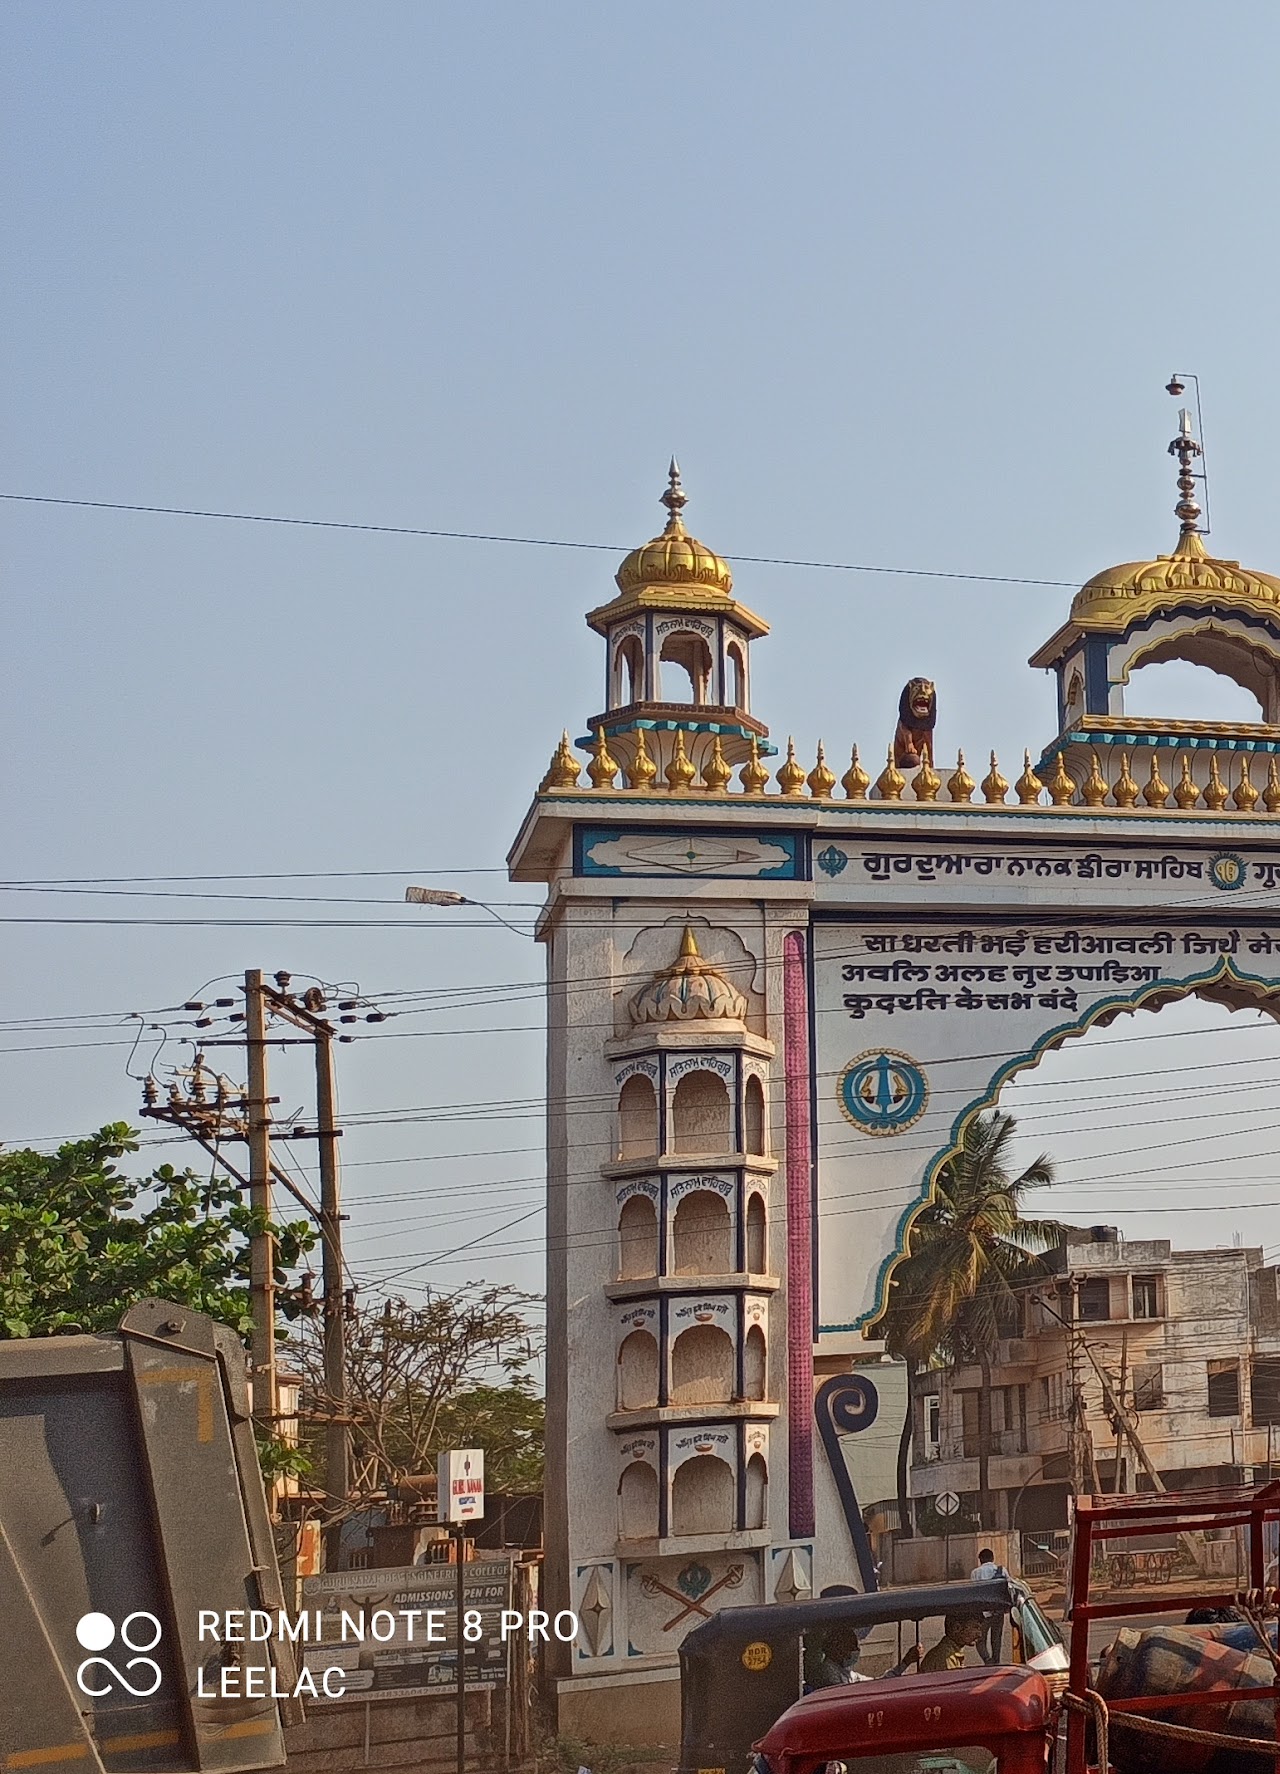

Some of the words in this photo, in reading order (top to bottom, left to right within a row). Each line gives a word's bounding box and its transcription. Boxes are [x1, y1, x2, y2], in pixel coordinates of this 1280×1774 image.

[1007, 857, 1072, 878] ਨਾਨਕ
[1134, 856, 1203, 879] ਸਾਹਿਬ
[862, 935, 897, 953] सा
[902, 931, 975, 953] धरती
[980, 929, 1029, 956] भई
[1034, 931, 1175, 954] हरीआवली
[842, 960, 931, 982] अवलि
[935, 965, 1008, 982] अलह
[1013, 965, 1053, 989] नुर
[843, 988, 950, 1019] कुदरति
[955, 986, 983, 1010] के
[985, 992, 1033, 1010] सभ
[1036, 987, 1078, 1011] बंदे
[405, 1566, 468, 1581] ENGINEERIG
[470, 1565, 508, 1577] COLLEGE
[394, 1590, 455, 1604] ADMISSIONS
[463, 1588, 483, 1598] PEN
[485, 1587, 504, 1598] FOR
